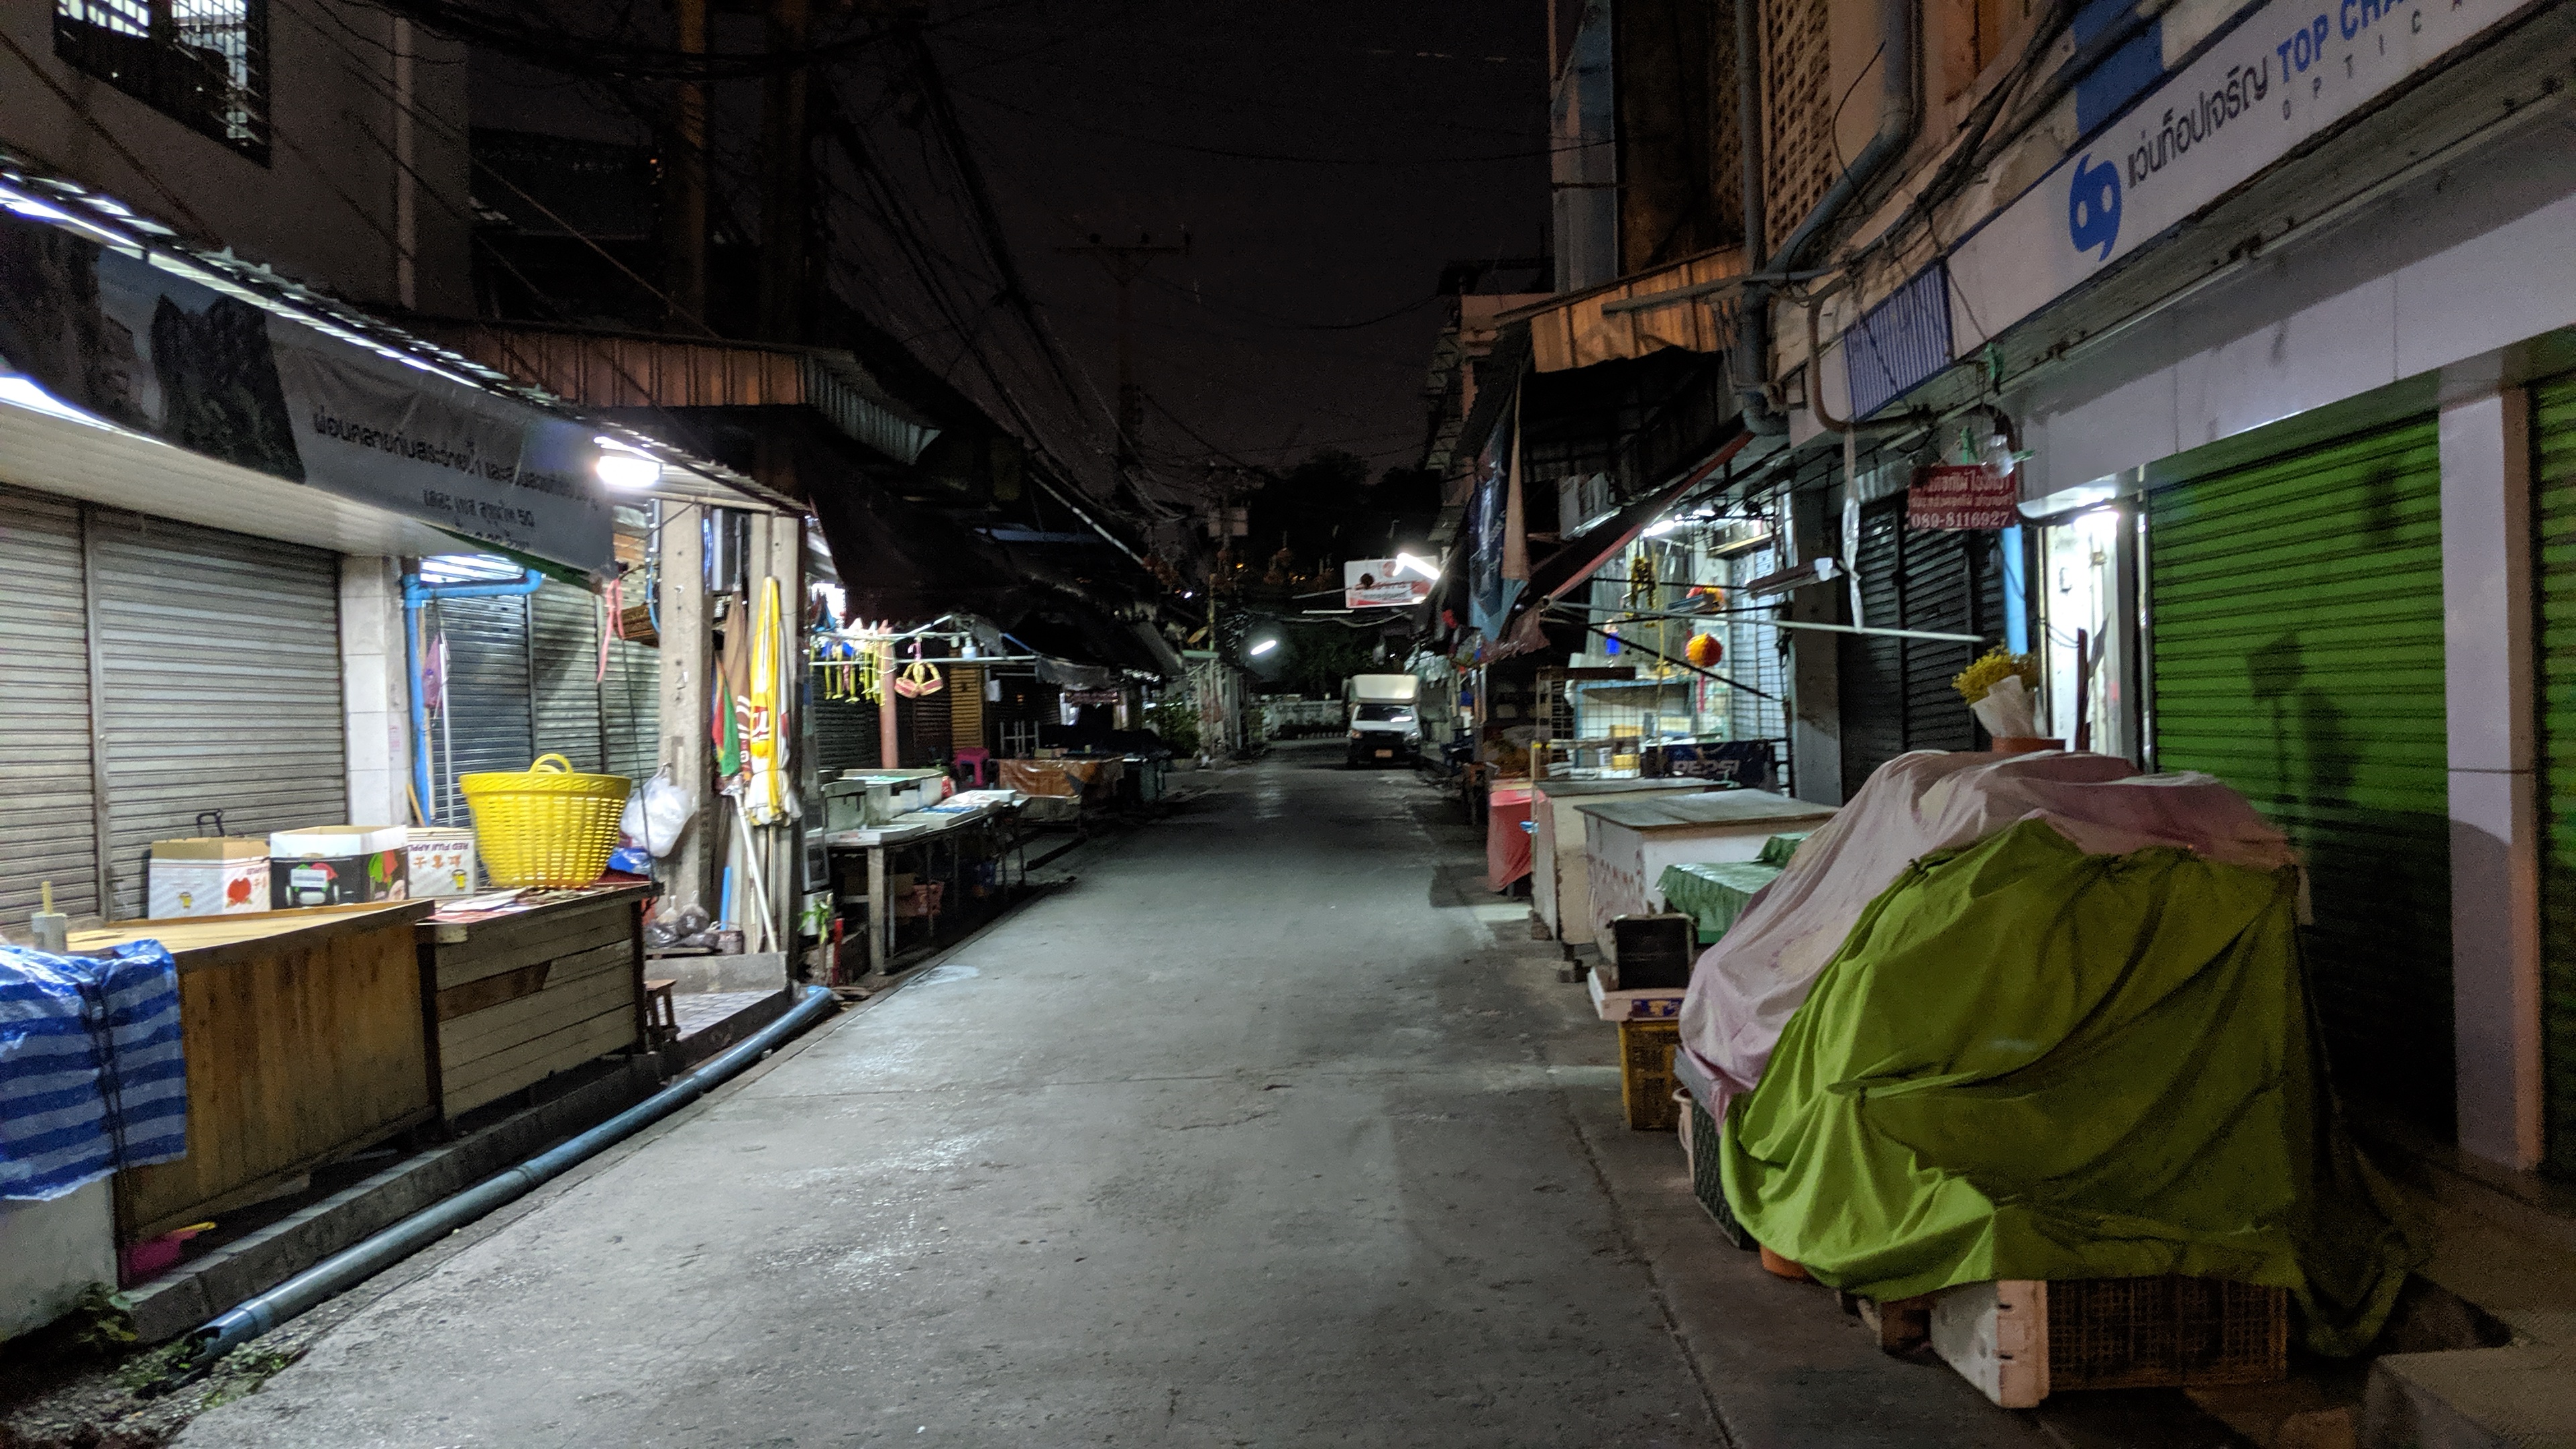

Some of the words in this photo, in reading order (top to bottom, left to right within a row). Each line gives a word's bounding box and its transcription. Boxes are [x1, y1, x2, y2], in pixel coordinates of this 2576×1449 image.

[2276, 14, 2329, 83] TOP
[2339, 0, 2403, 40] CH
[2128, 55, 2267, 189] แว่นท็อปเจริญ
[1672, 759, 1740, 775] PEPSI
[408, 844, 431, 852] APPL
[431, 843, 451, 851] FUJI
[452, 843, 469, 851] RED
